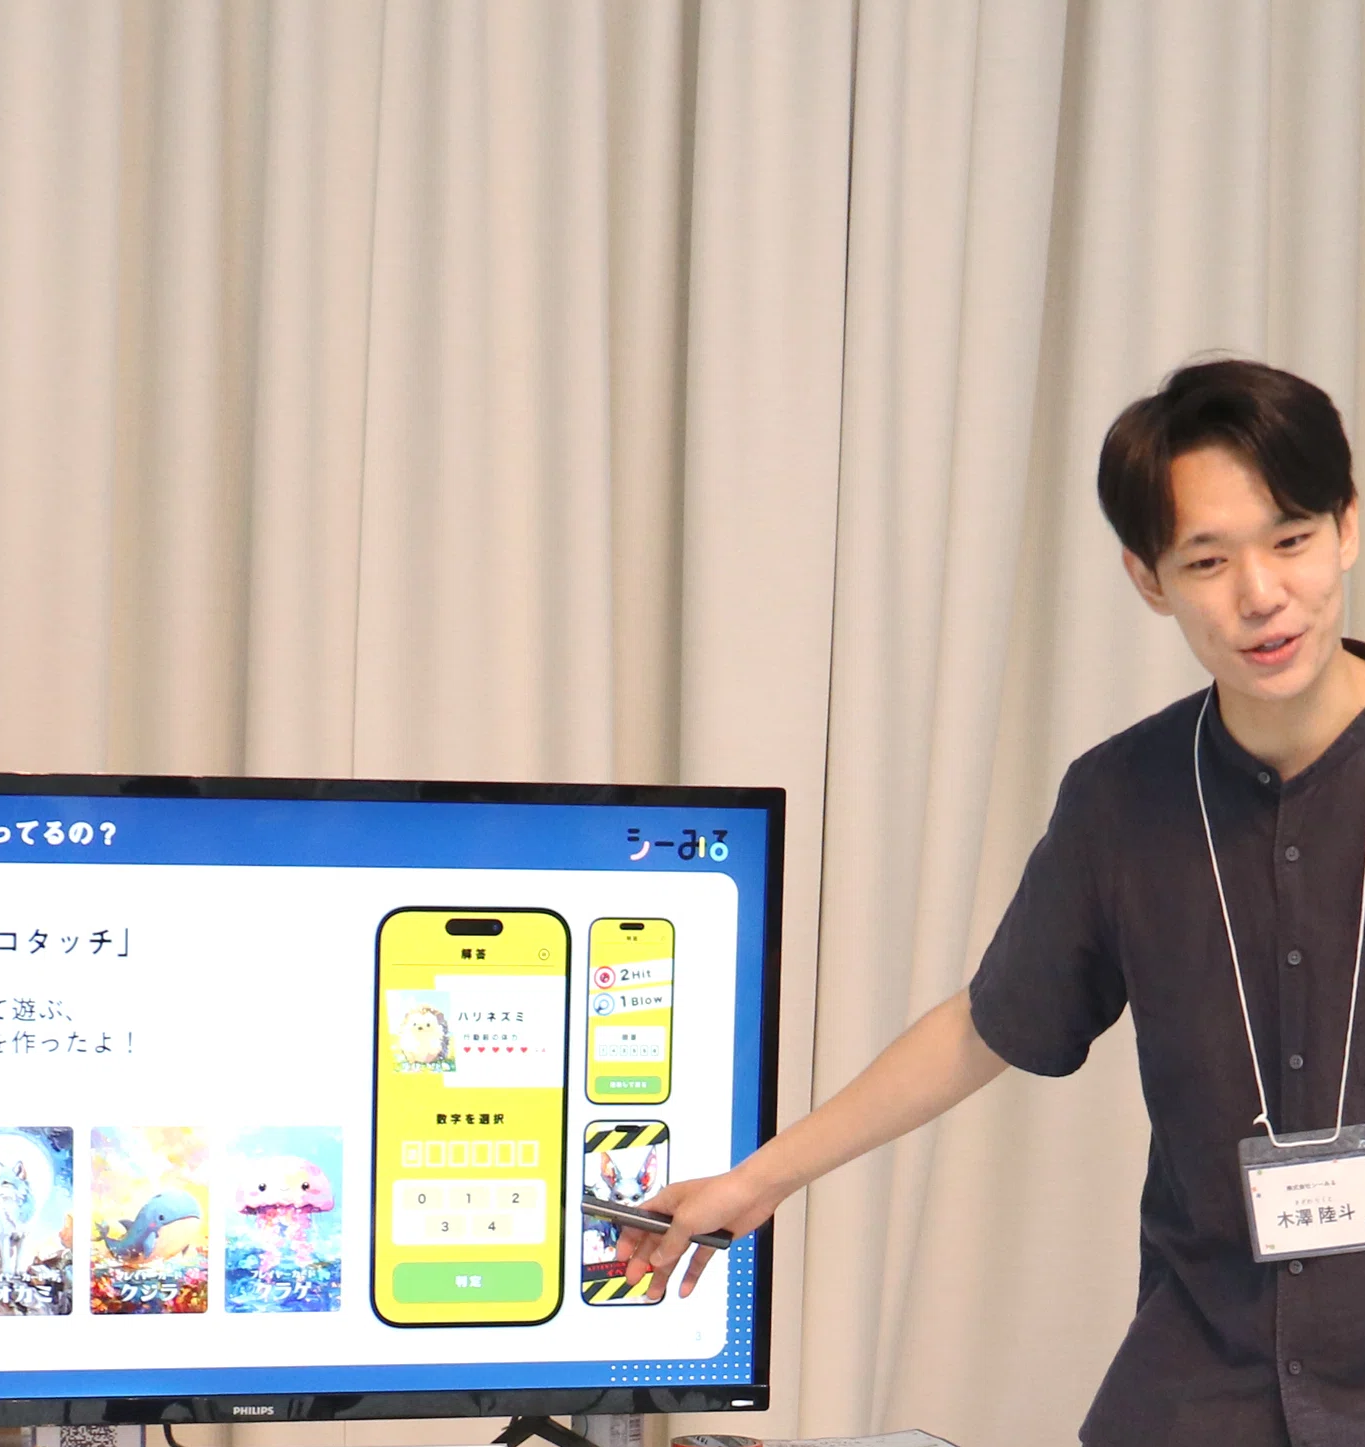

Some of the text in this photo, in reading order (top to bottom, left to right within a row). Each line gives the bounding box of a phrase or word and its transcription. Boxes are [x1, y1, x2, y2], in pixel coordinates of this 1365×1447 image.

[631, 969, 651, 980] Hit
[631, 995, 663, 1007] Blow
[458, 1011, 524, 1023] ハリネズミ
[436, 1113, 505, 1125] 数字を選択
[417, 1193, 520, 1205] 0 1 2
[441, 1221, 496, 1232] 3 4
[120, 1283, 180, 1301] クジラ
[232, 1406, 274, 1416] PHILIPS
